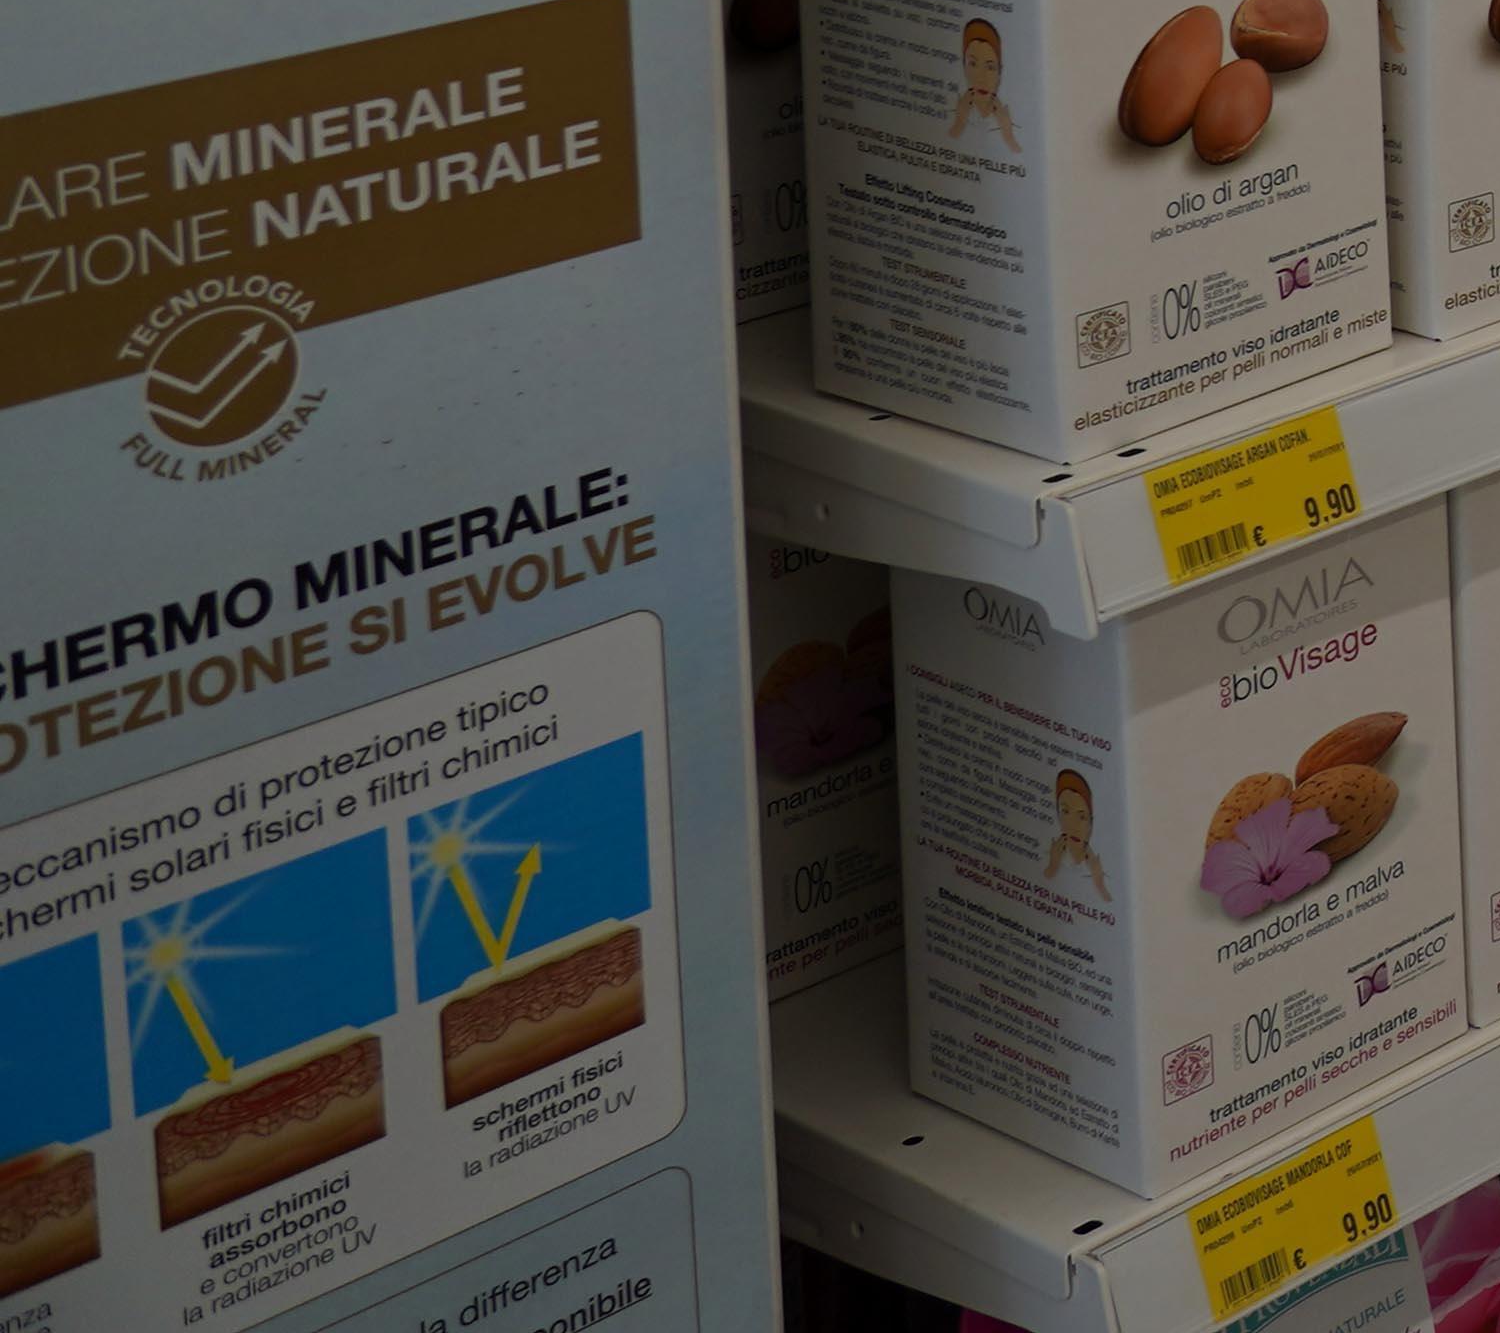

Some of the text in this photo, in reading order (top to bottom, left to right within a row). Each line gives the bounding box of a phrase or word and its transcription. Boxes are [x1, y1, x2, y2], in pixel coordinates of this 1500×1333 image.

[171, 66, 528, 191] MINERALE
[251, 120, 602, 247] NATURALE
[1166, 161, 1300, 221] olio di argan
[119, 274, 317, 364] TECNOLOGIA
[1125, 307, 1341, 396] trattamento viso idratante
[1073, 305, 1389, 433] elasticizzante per pelli normali miste
[120, 384, 328, 483] FULL MINERAL
[1303, 482, 1358, 530] 9.90
[0, 465, 629, 703] HERMO MINERALE:
[349, 598, 409, 655] SI
[426, 515, 657, 633] EVOLVE
[1232, 619, 1379, 705] bioVisage
[213, 782, 246, 819] di
[259, 718, 447, 806] protezione
[456, 681, 550, 737] tipico
[129, 832, 231, 895] solari
[242, 799, 325, 859] fisici
[336, 792, 358, 819] e
[366, 759, 430, 810] filtri
[440, 714, 560, 781] chimici
[1217, 858, 1406, 966] mandorla e malva
[471, 1050, 625, 1132] schermi fisici
[1170, 997, 1458, 1161] nutriente per pelli secche sensibili
[1208, 1004, 1418, 1125] trattamento viso idratante
[463, 1085, 637, 1180] la radiazione UV
[496, 1082, 602, 1145] riflettono
[202, 1170, 352, 1252] filtri chimici
[208, 1196, 349, 1270] assorbono
[1293, 1193, 1393, 1270] € 9.90
[460, 1235, 620, 1328] differenza
